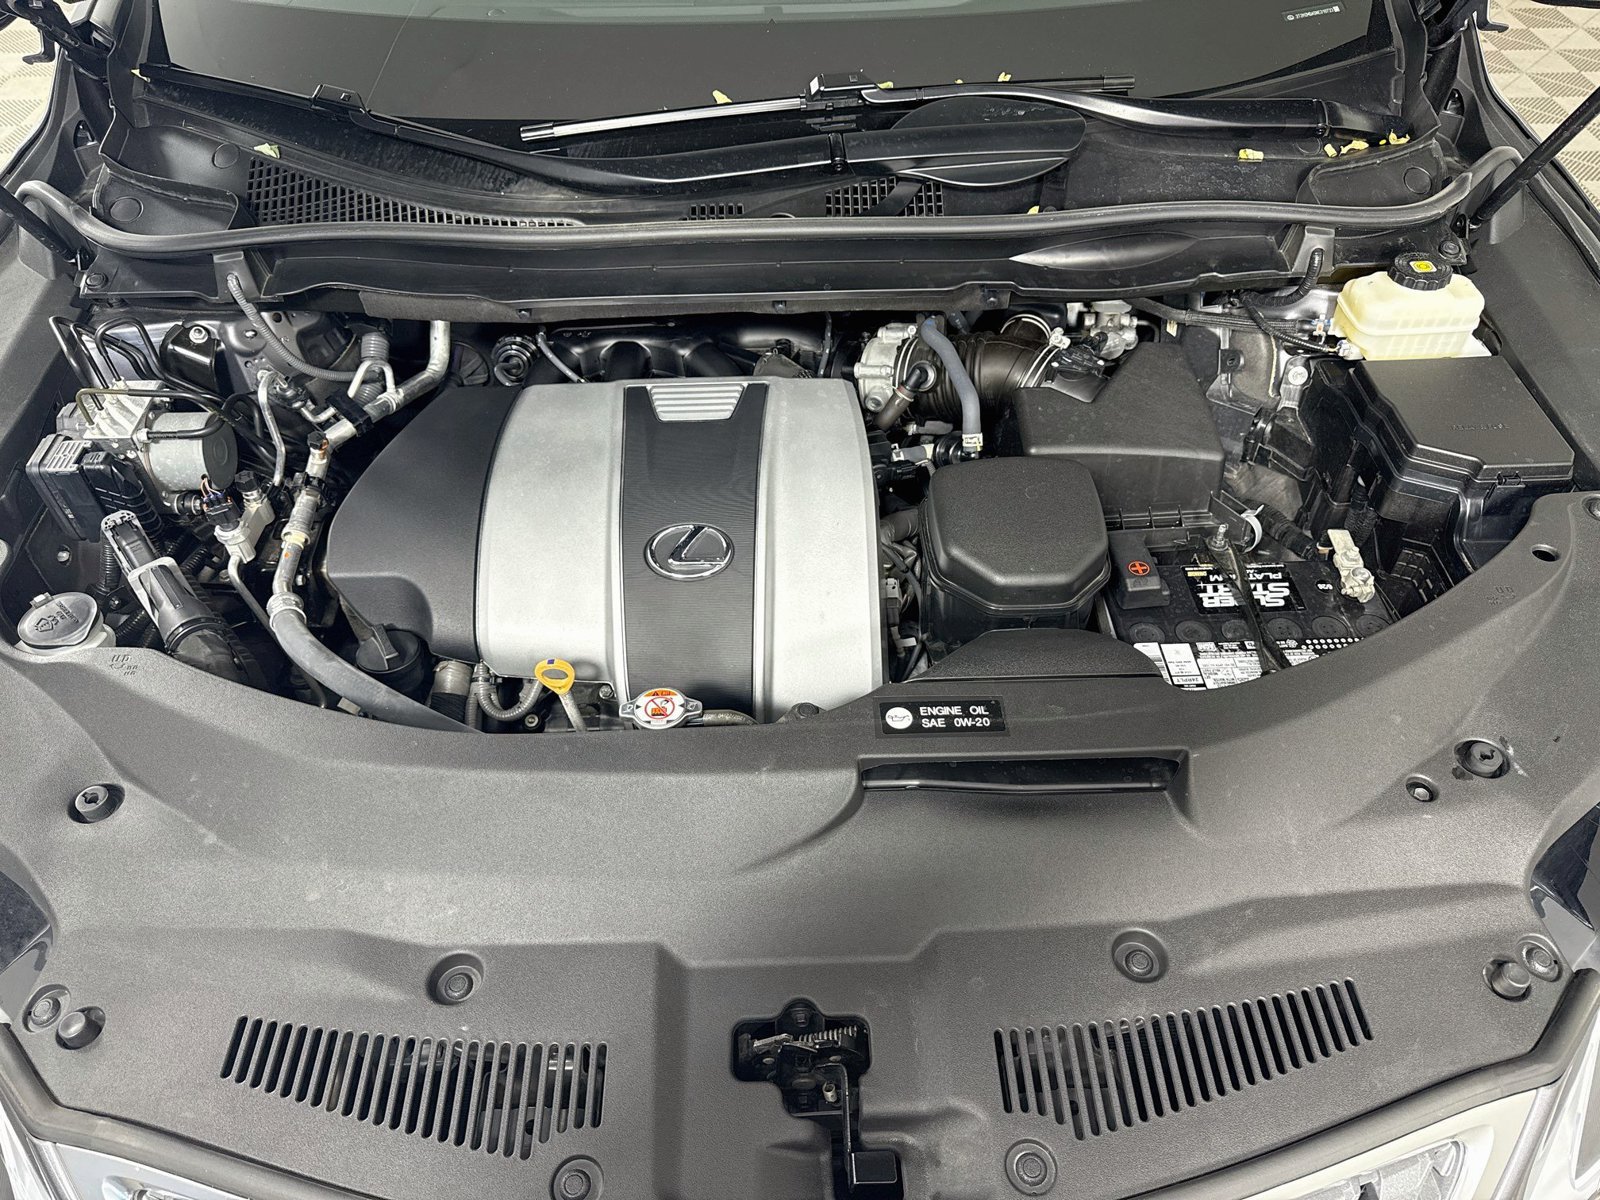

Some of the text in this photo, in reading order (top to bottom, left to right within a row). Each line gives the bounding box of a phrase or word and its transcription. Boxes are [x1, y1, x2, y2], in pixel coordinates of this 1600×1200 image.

[920, 705, 990, 716] ENGINE OIL
[921, 717, 991, 728] SAE 0W-20
